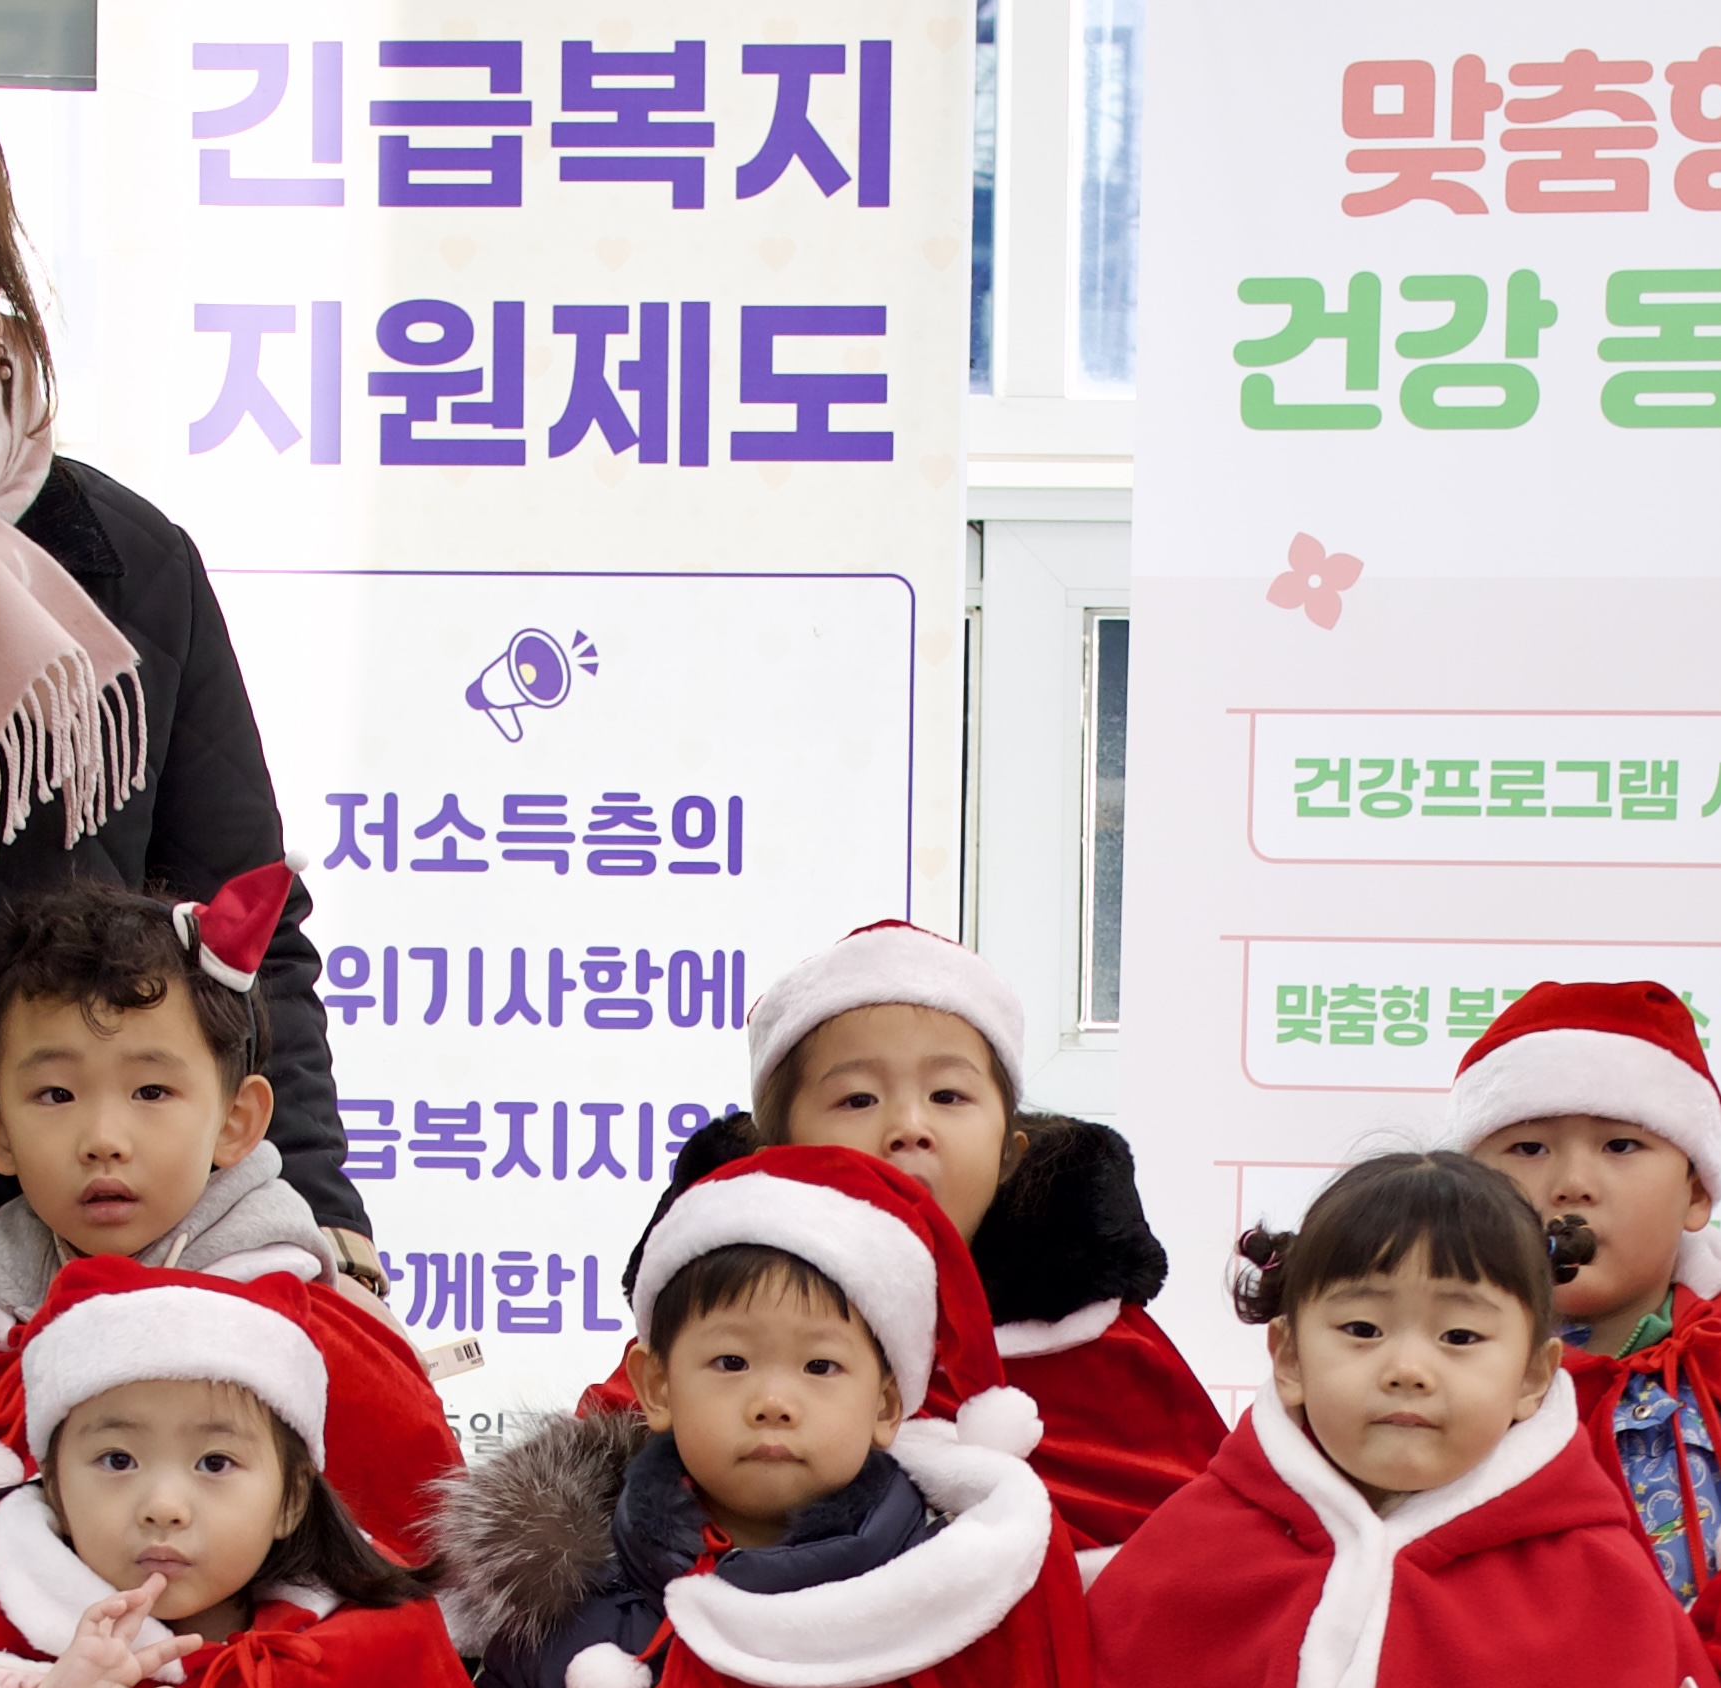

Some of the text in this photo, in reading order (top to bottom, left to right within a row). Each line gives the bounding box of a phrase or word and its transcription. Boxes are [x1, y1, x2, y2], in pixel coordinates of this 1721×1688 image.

[191, 40, 893, 210] 긴급복지
[188, 298, 894, 468] 지원제도
[1232, 268, 1558, 431] 건강
[1293, 757, 1679, 820] 건강프로그램
[323, 791, 745, 877] 저소득층의
[323, 945, 747, 1032] 위기사항에
[1274, 983, 1429, 1047] 맞춤형
